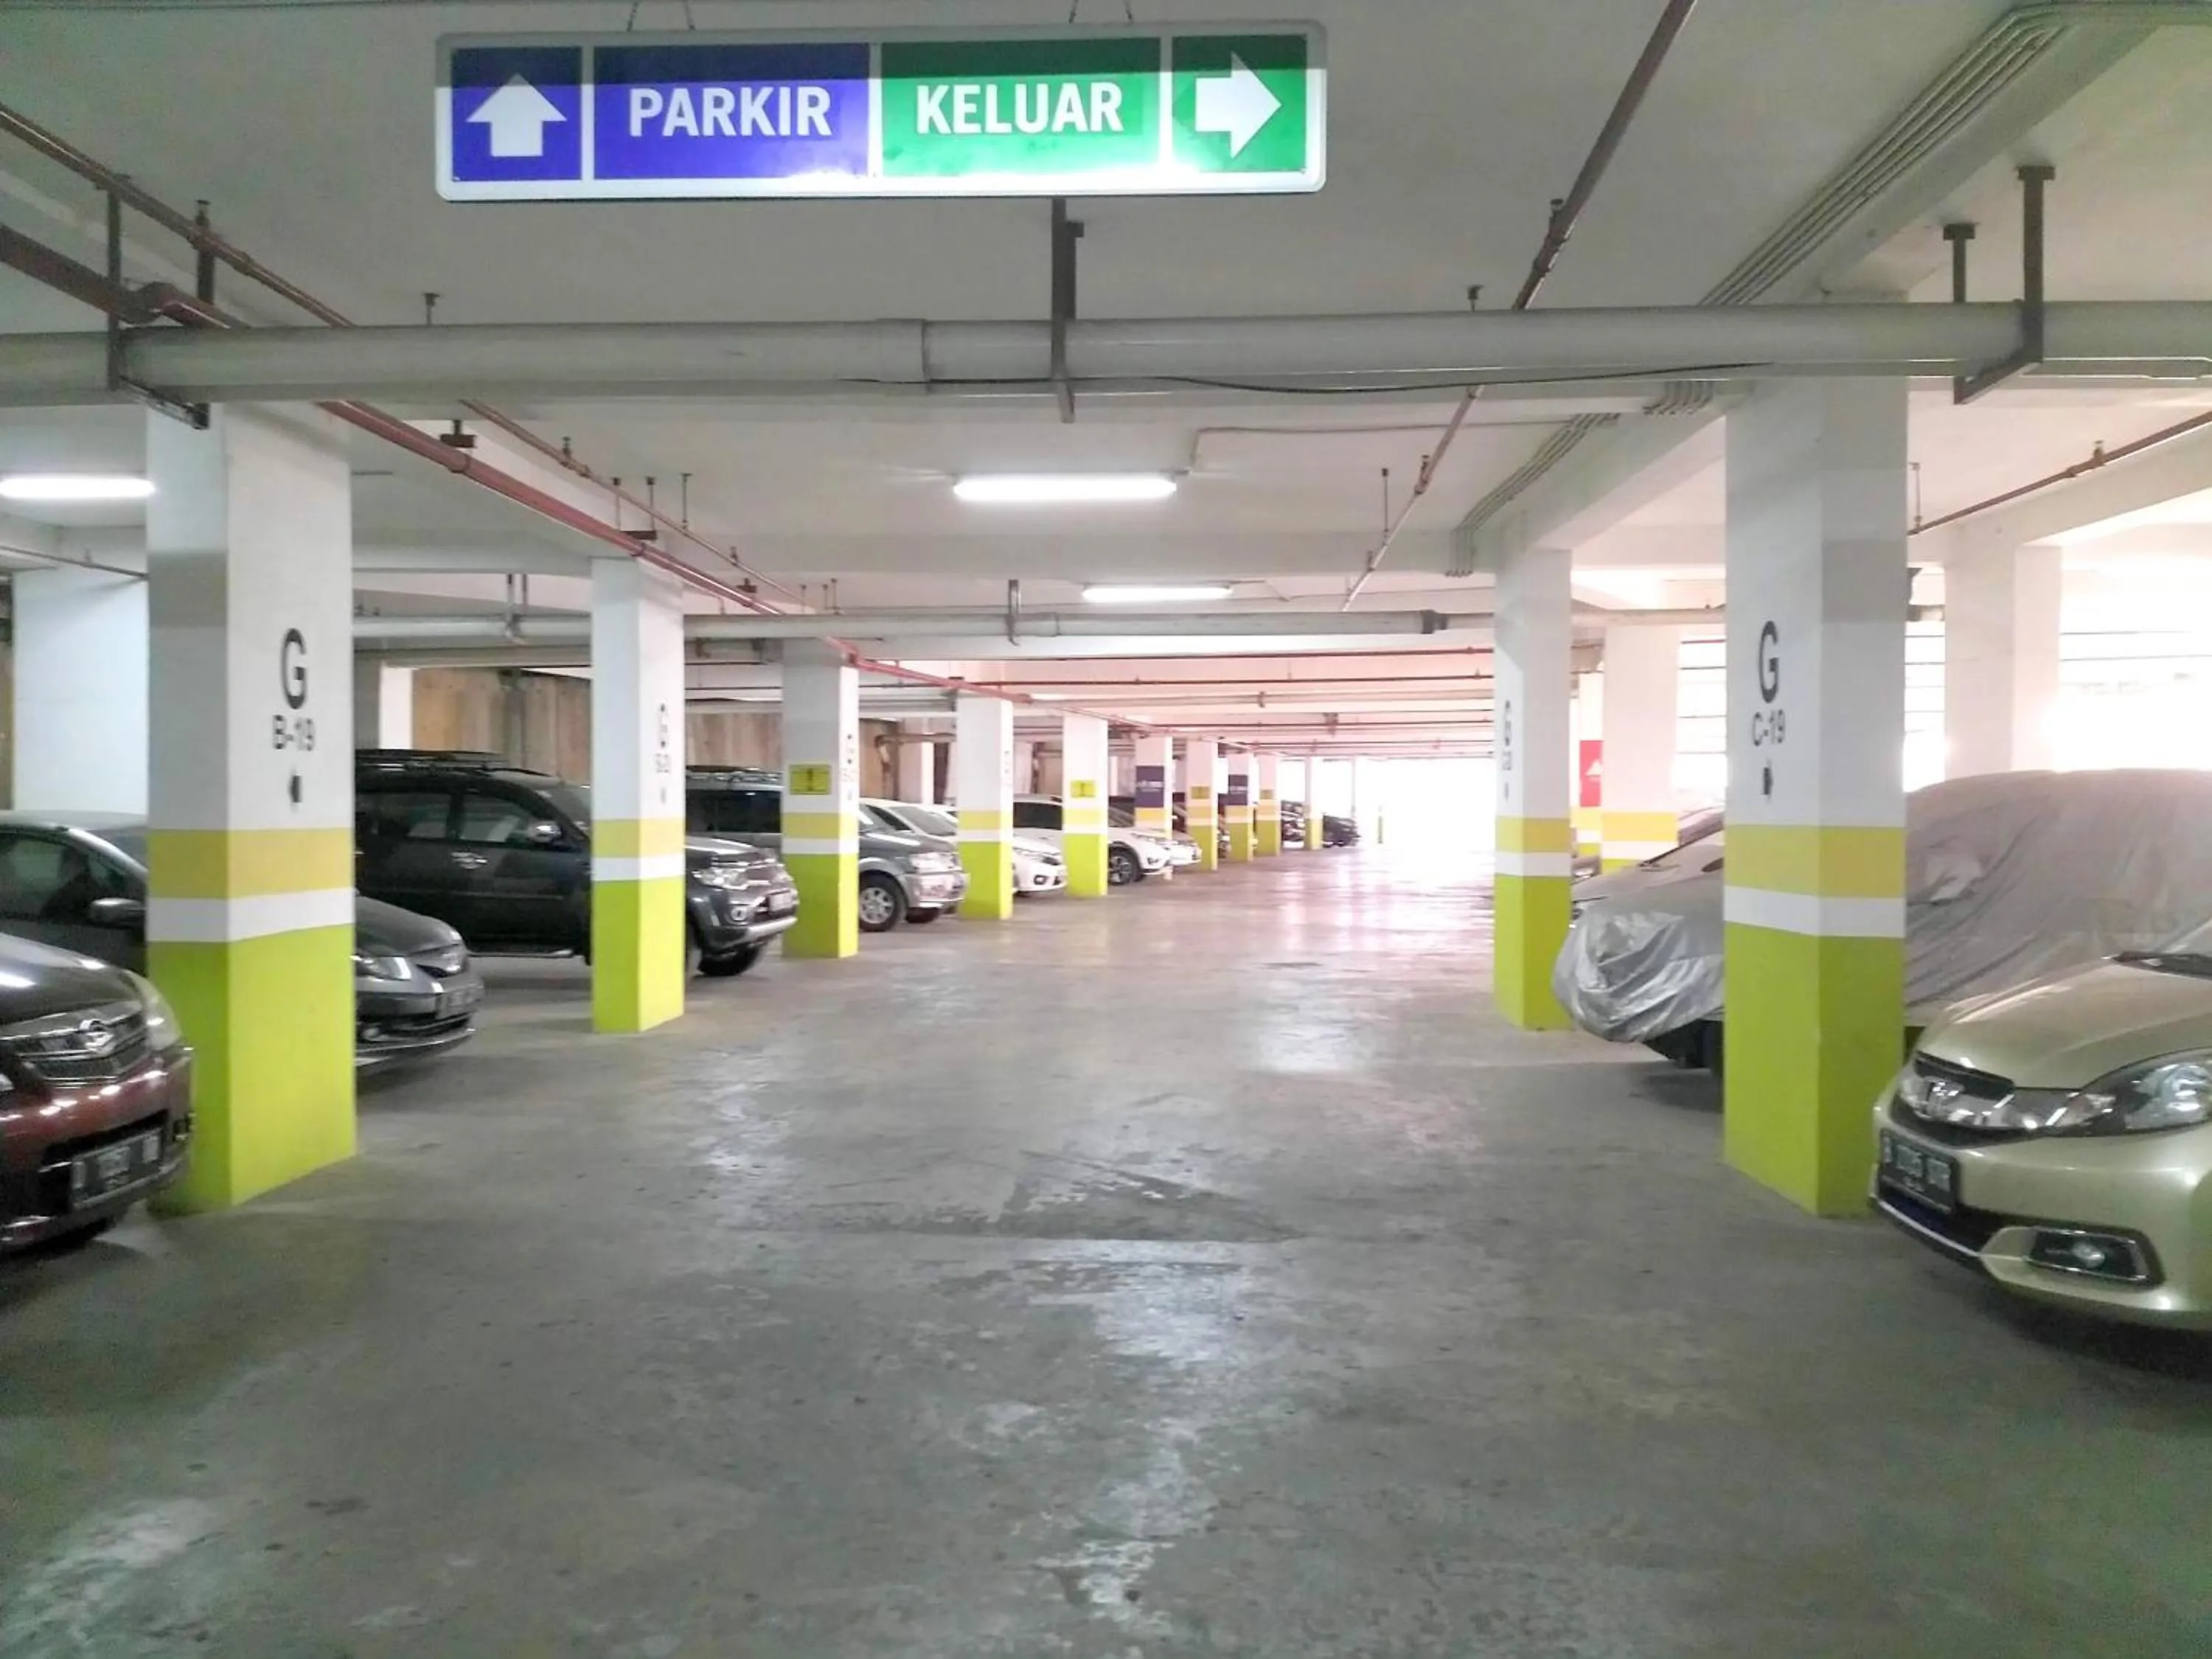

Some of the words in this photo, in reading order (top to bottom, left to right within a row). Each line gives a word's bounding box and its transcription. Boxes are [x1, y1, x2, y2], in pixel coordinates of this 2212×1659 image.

[630, 86, 832, 137] PARKIR
[917, 82, 1124, 134] KELUAR
[280, 628, 307, 710] G
[1759, 620, 1779, 703] G
[272, 714, 316, 751] B-19
[1753, 709, 1786, 747] C-19
